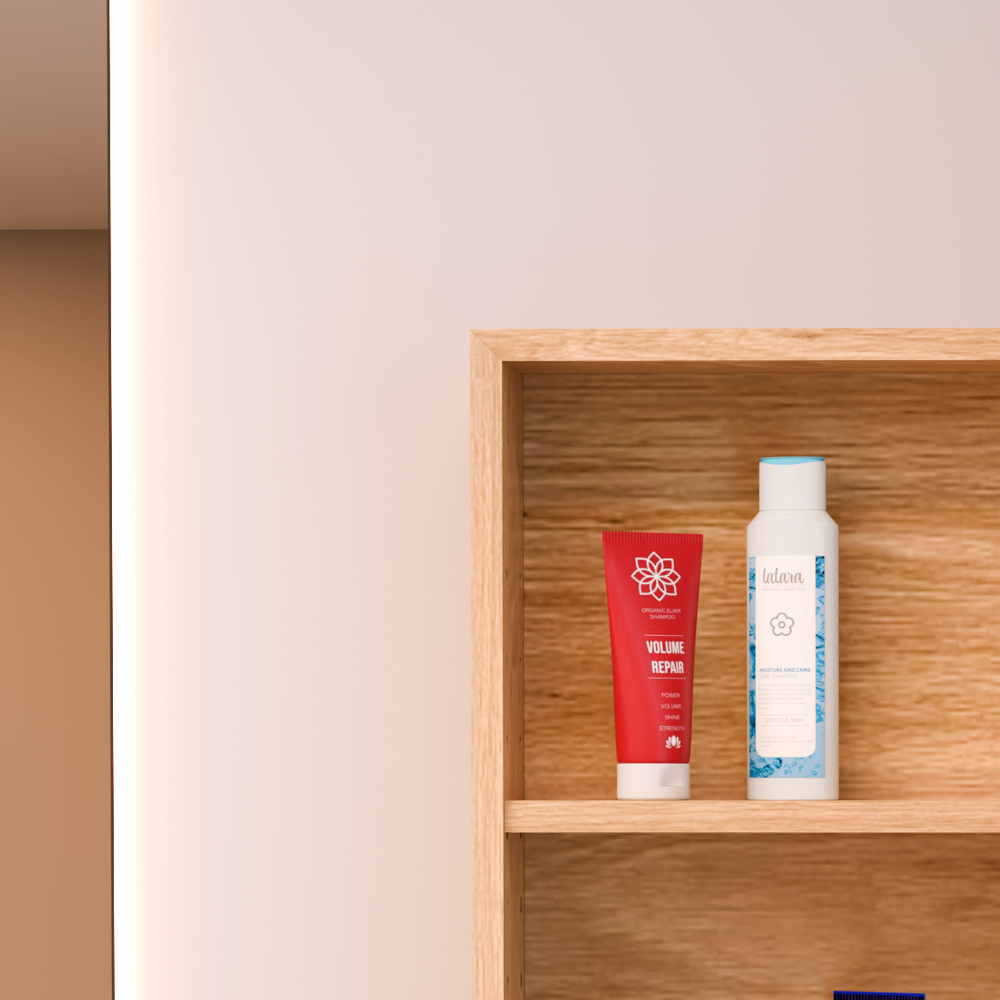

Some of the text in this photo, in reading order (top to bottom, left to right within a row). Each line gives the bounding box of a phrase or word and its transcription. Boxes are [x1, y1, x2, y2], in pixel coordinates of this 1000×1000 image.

[762, 568, 805, 584] latara
[646, 641, 685, 654] VOLUME
[651, 661, 684, 674] REPAIR
